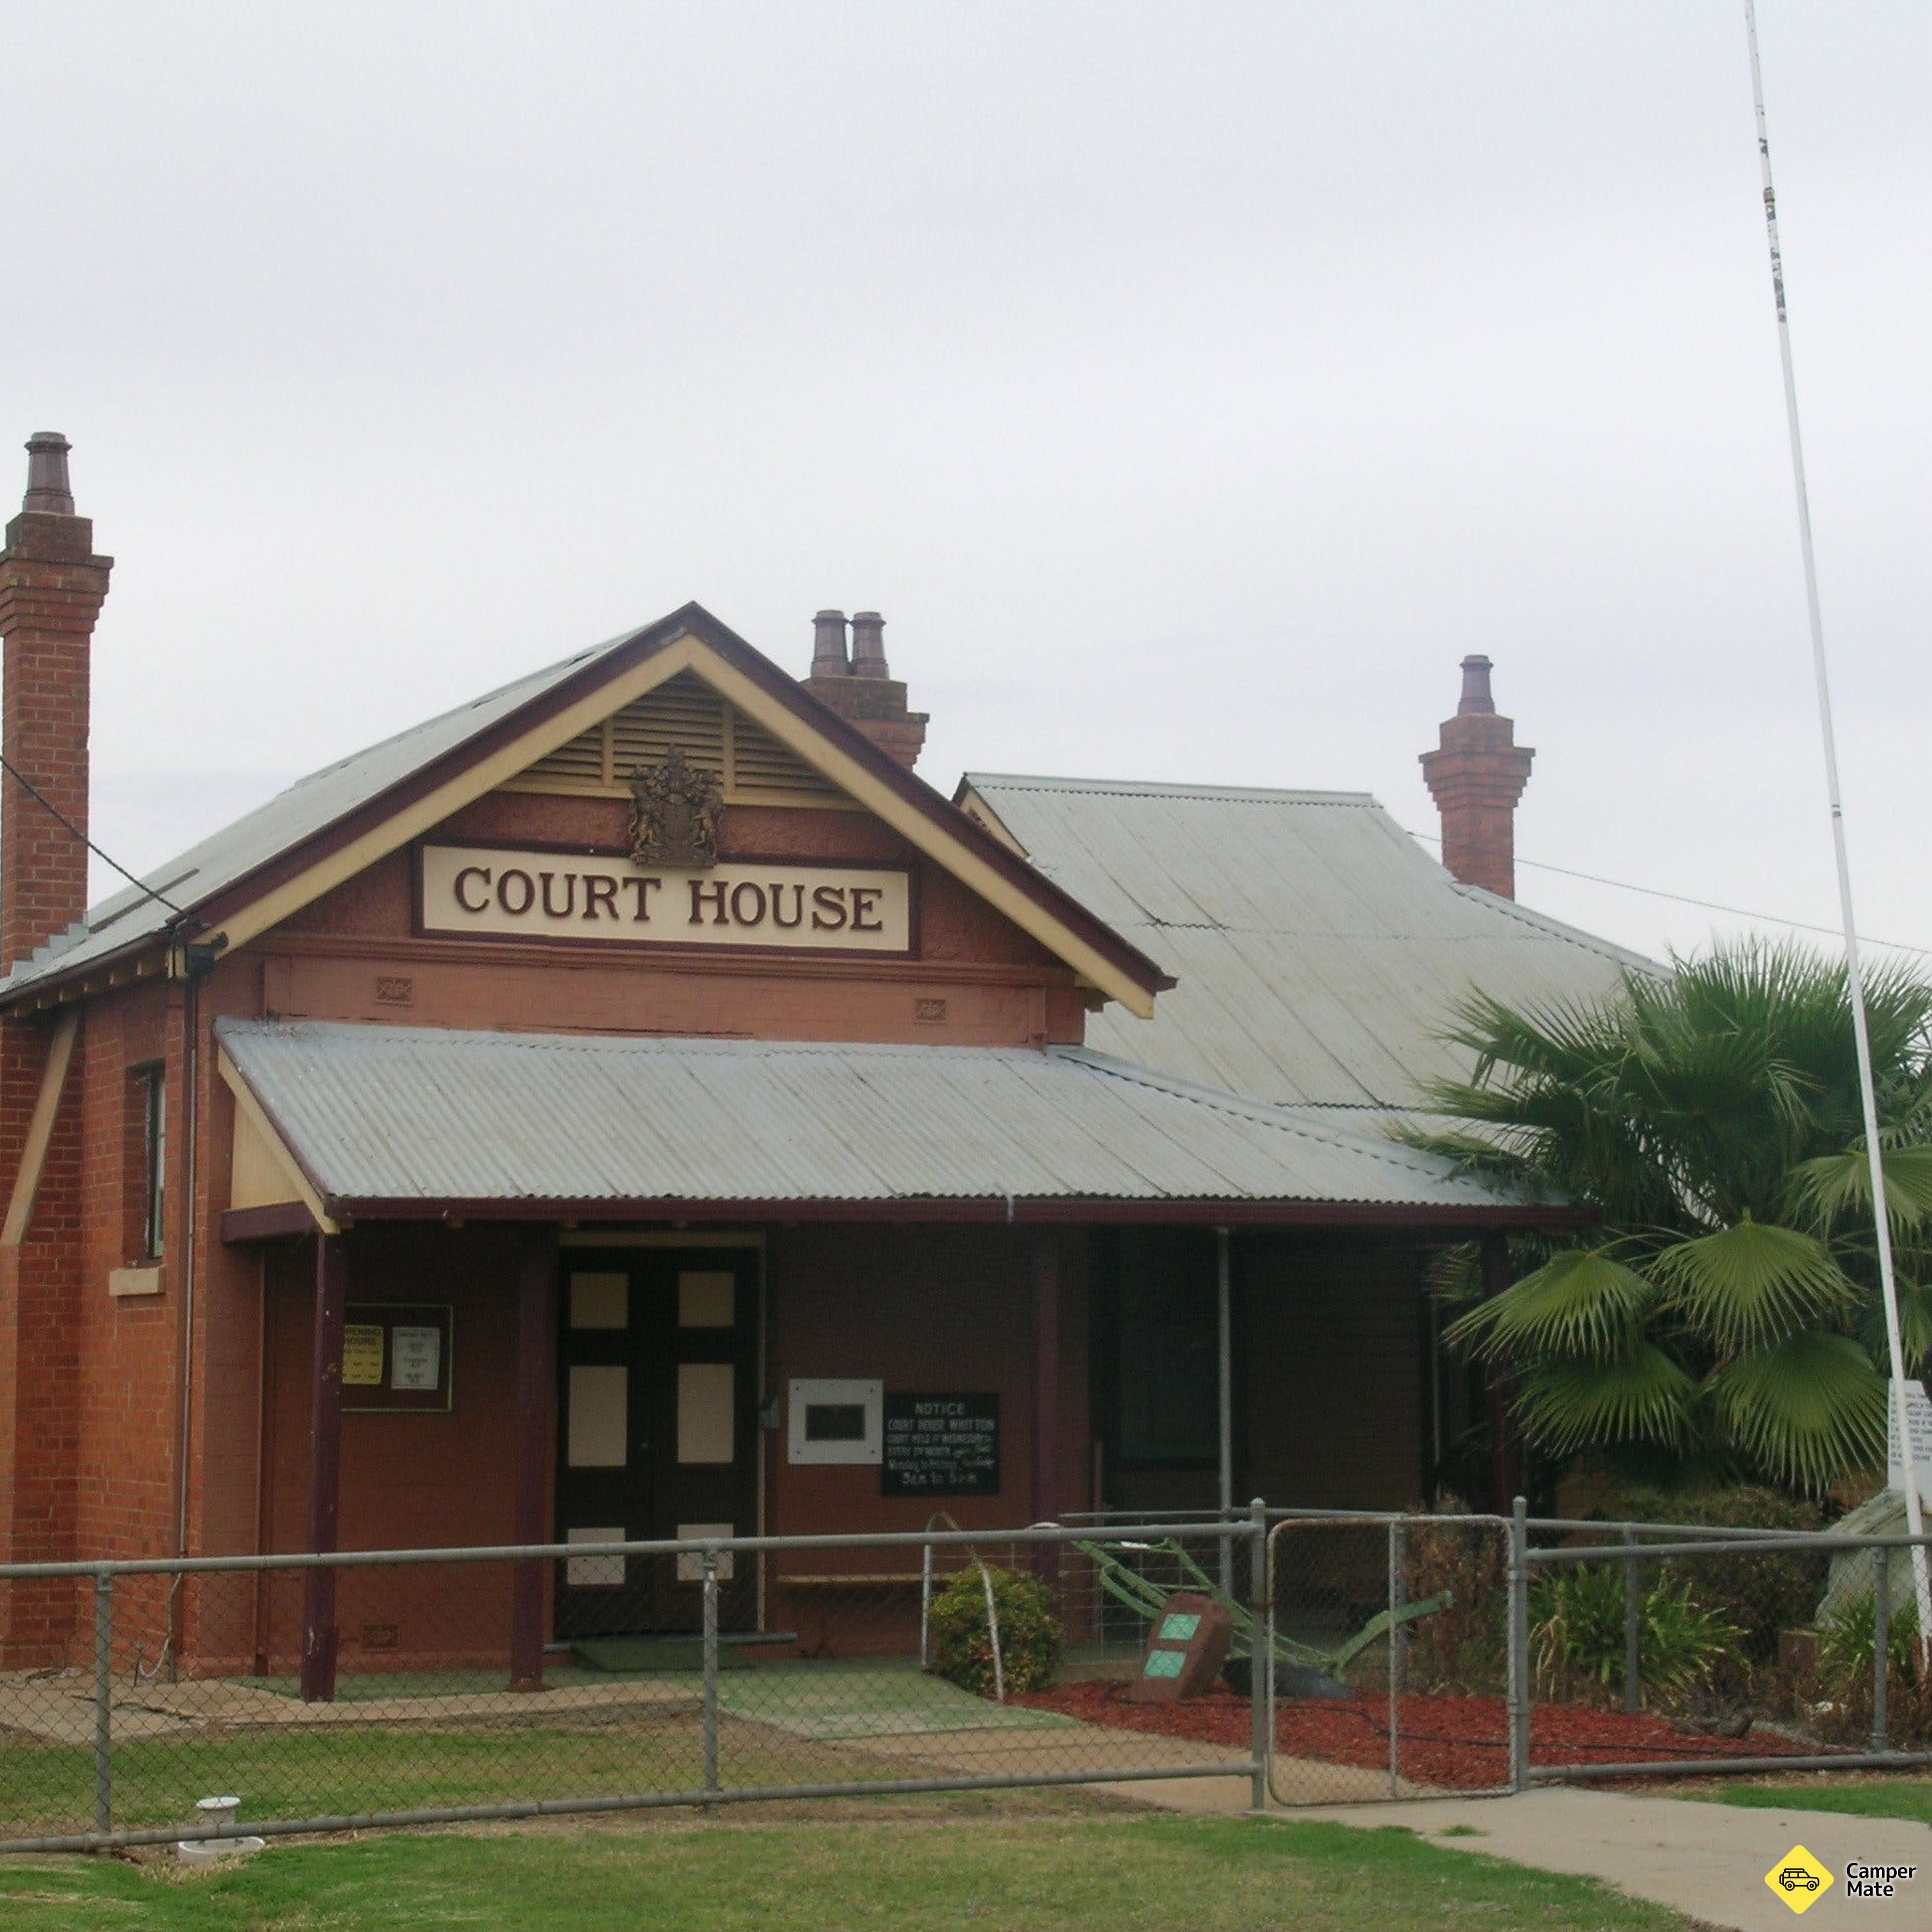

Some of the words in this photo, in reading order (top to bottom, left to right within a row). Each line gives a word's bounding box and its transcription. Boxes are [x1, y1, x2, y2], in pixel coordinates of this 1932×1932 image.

[454, 867, 661, 922] COURT
[688, 880, 883, 931] HOUSE
[915, 1402, 966, 1415] NOTICE
